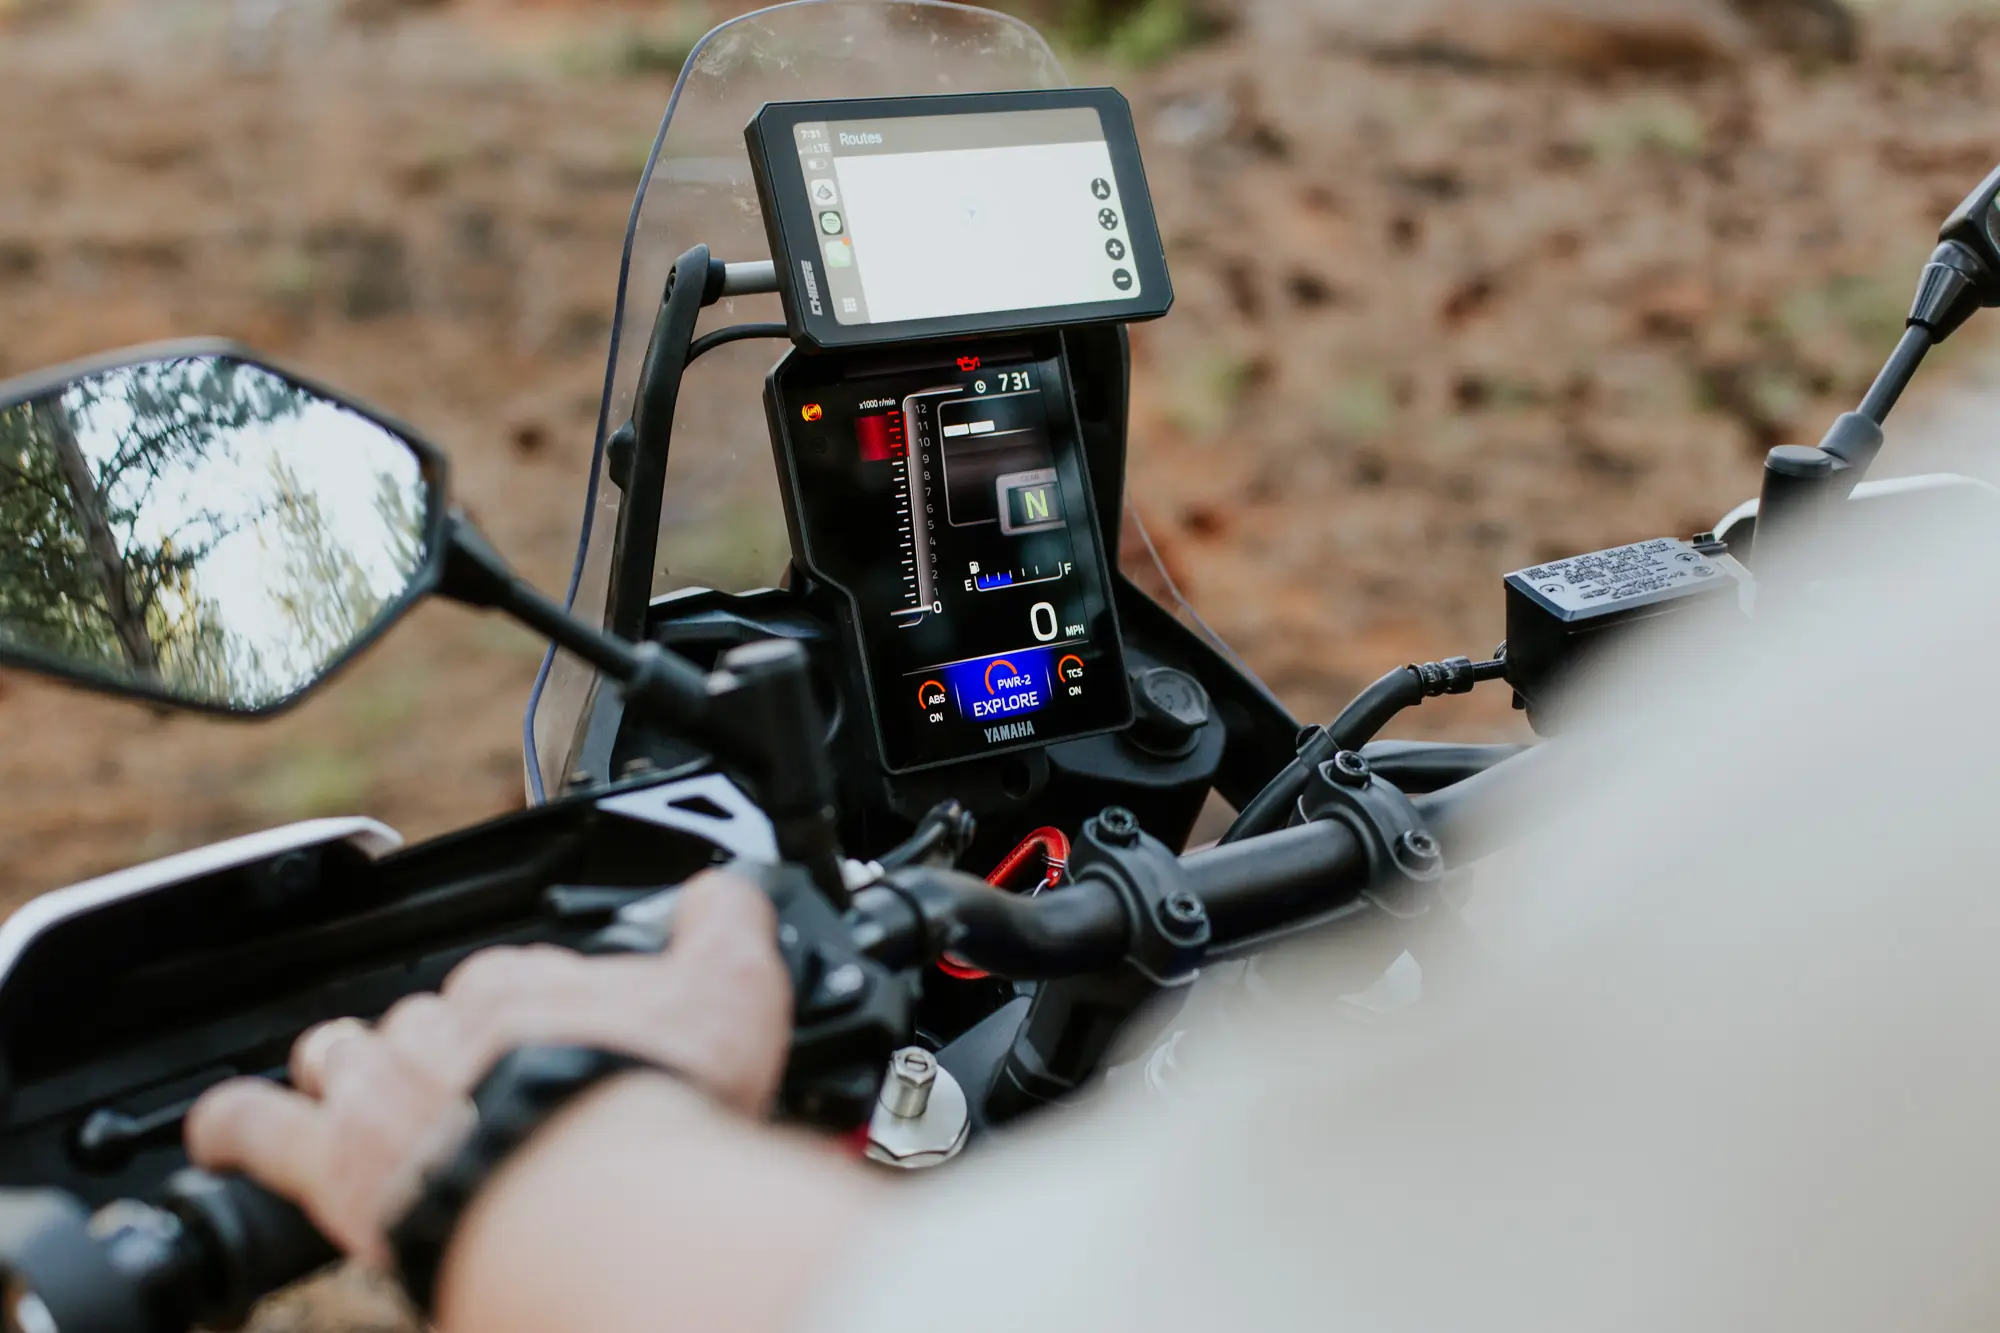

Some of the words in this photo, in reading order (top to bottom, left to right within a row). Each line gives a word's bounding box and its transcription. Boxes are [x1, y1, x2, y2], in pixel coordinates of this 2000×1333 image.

[800, 129, 820, 140] 7:31
[839, 131, 883, 146] Routes
[813, 143, 829, 153] LTE
[879, 398, 896, 408] r/min
[915, 404, 927, 414] 12
[917, 421, 929, 431] 11
[919, 437, 931, 447] 10
[922, 454, 930, 464] 9
[923, 471, 931, 480] 8
[924, 487, 931, 496] 7
[926, 503, 934, 513] 6
[1024, 489, 1049, 520] N
[927, 520, 935, 530] 5
[929, 537, 937, 546] 4
[930, 553, 937, 563] 3
[1064, 562, 1072, 575] F
[931, 570, 938, 579] 2
[964, 579, 973, 591] E
[933, 587, 939, 596] 1
[933, 600, 942, 613] 0
[1029, 602, 1058, 642] 0
[1065, 624, 1085, 637] MPH
[1066, 668, 1083, 678] TCS
[997, 674, 1032, 690] PWR-2
[1068, 686, 1082, 696] ON
[928, 694, 946, 706] ABS
[973, 691, 1040, 717] EXPLORE
[929, 712, 943, 723] ON
[983, 720, 1036, 743] YAMAHA
